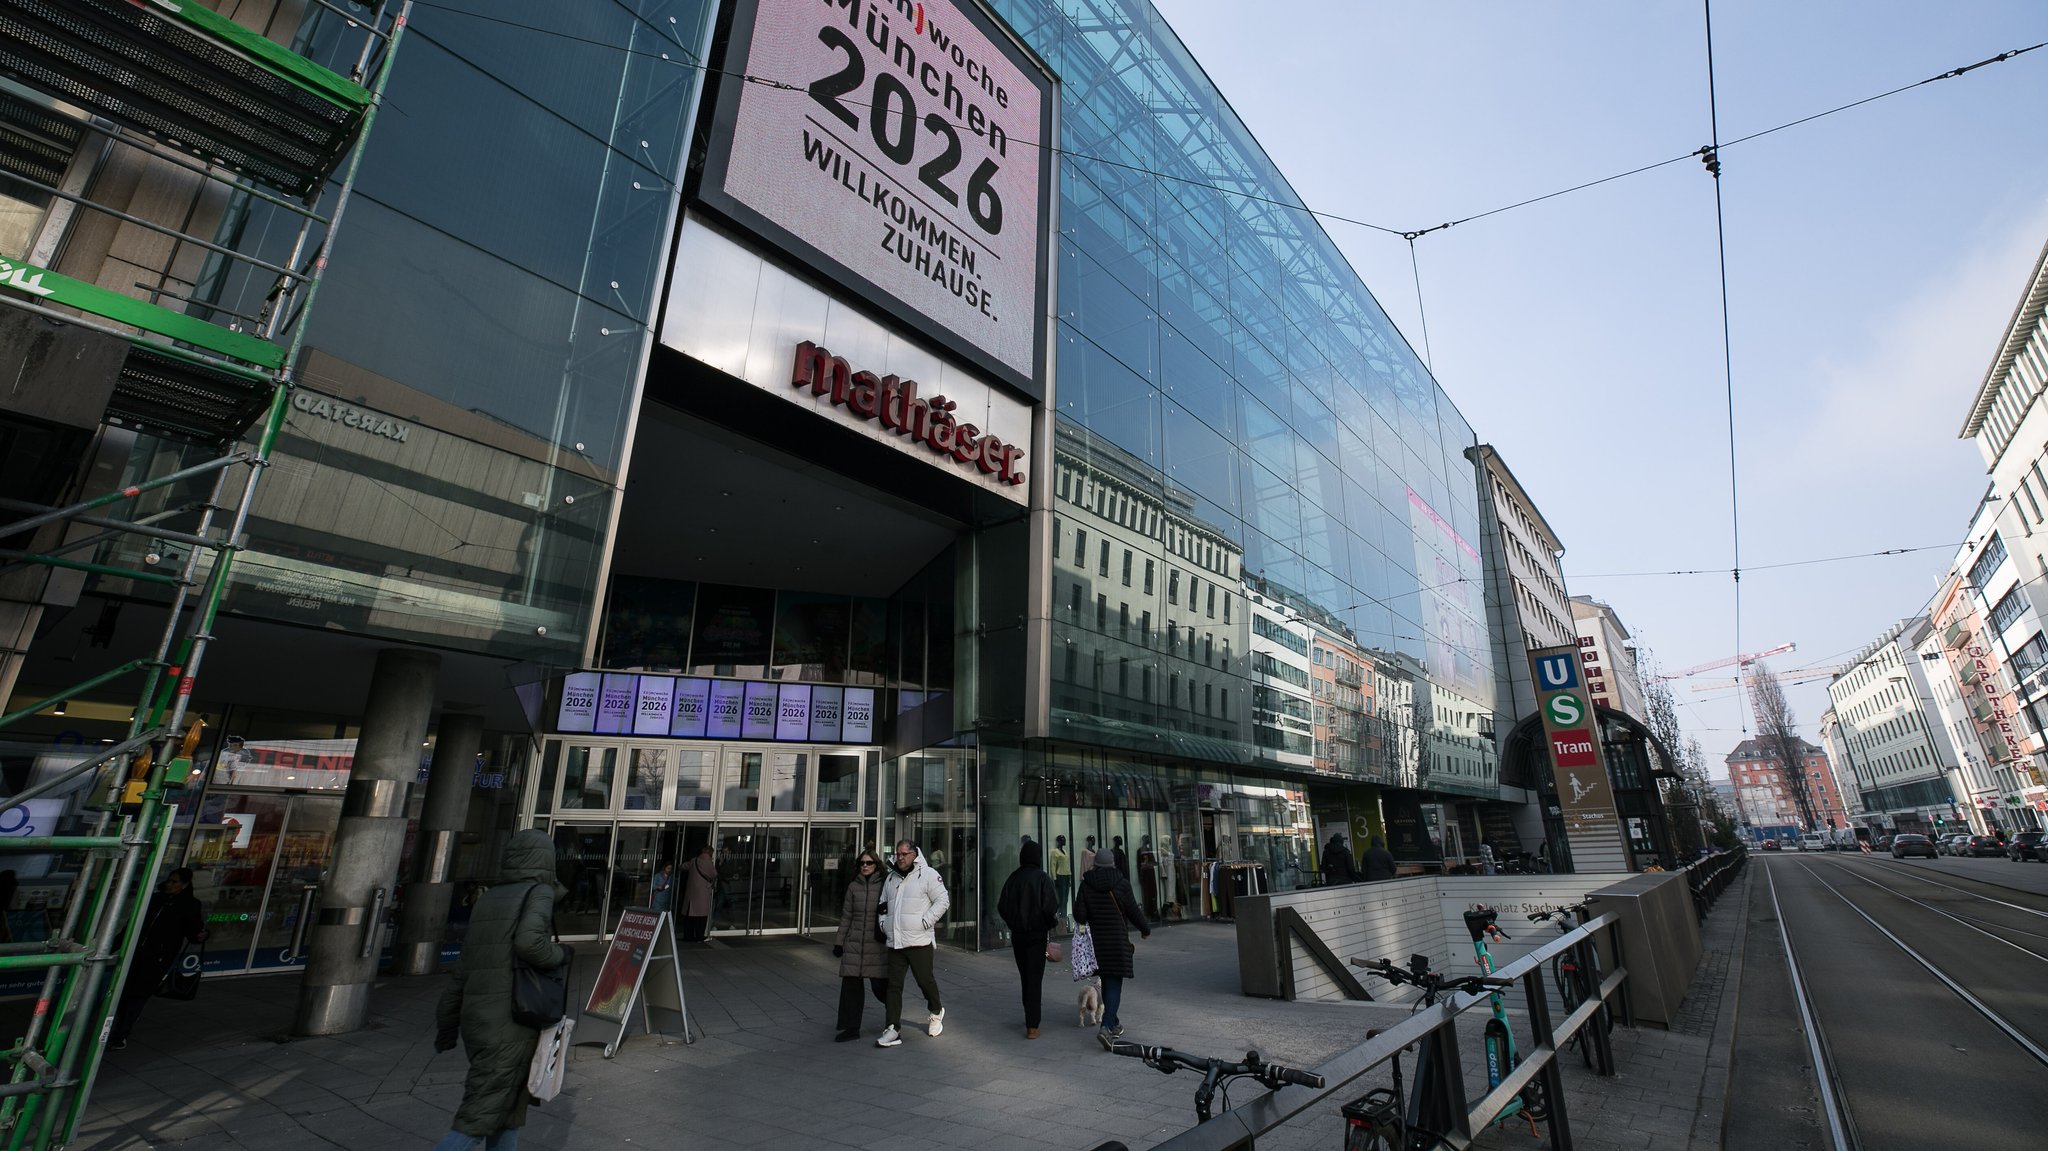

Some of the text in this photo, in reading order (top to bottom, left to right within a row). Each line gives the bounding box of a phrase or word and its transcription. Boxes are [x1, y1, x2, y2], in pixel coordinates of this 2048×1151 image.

[808, 25, 1003, 236] 2026
[803, 129, 982, 281] WILLKOMMEN.
[881, 222, 998, 322] ZUHAUSE.
[792, 340, 1026, 486] mathäser.
[1545, 658, 1569, 685] U
[566, 698, 592, 708] 2026
[604, 699, 630, 710] 2026
[642, 701, 666, 712] 2026
[678, 703, 702, 713] 2026
[1974, 659, 2024, 759] APOTHEKE
[713, 705, 738, 714] 2026
[748, 706, 772, 716] 2026
[782, 708, 805, 718] 2026
[816, 710, 837, 720] 2026
[1551, 696, 1582, 726] S
[847, 711, 869, 721] 2026
[1553, 739, 1593, 756] Tram
[1582, 812, 1604, 820] Stachus
[1355, 815, 1369, 839] 3
[1468, 903, 1518, 913] Klsplatz
[624, 913, 658, 926] HEUTE KEIN
[618, 927, 653, 941] ANSCHLUSS
[613, 940, 632, 952] PREIS
[26, 979, 45, 992] gute
